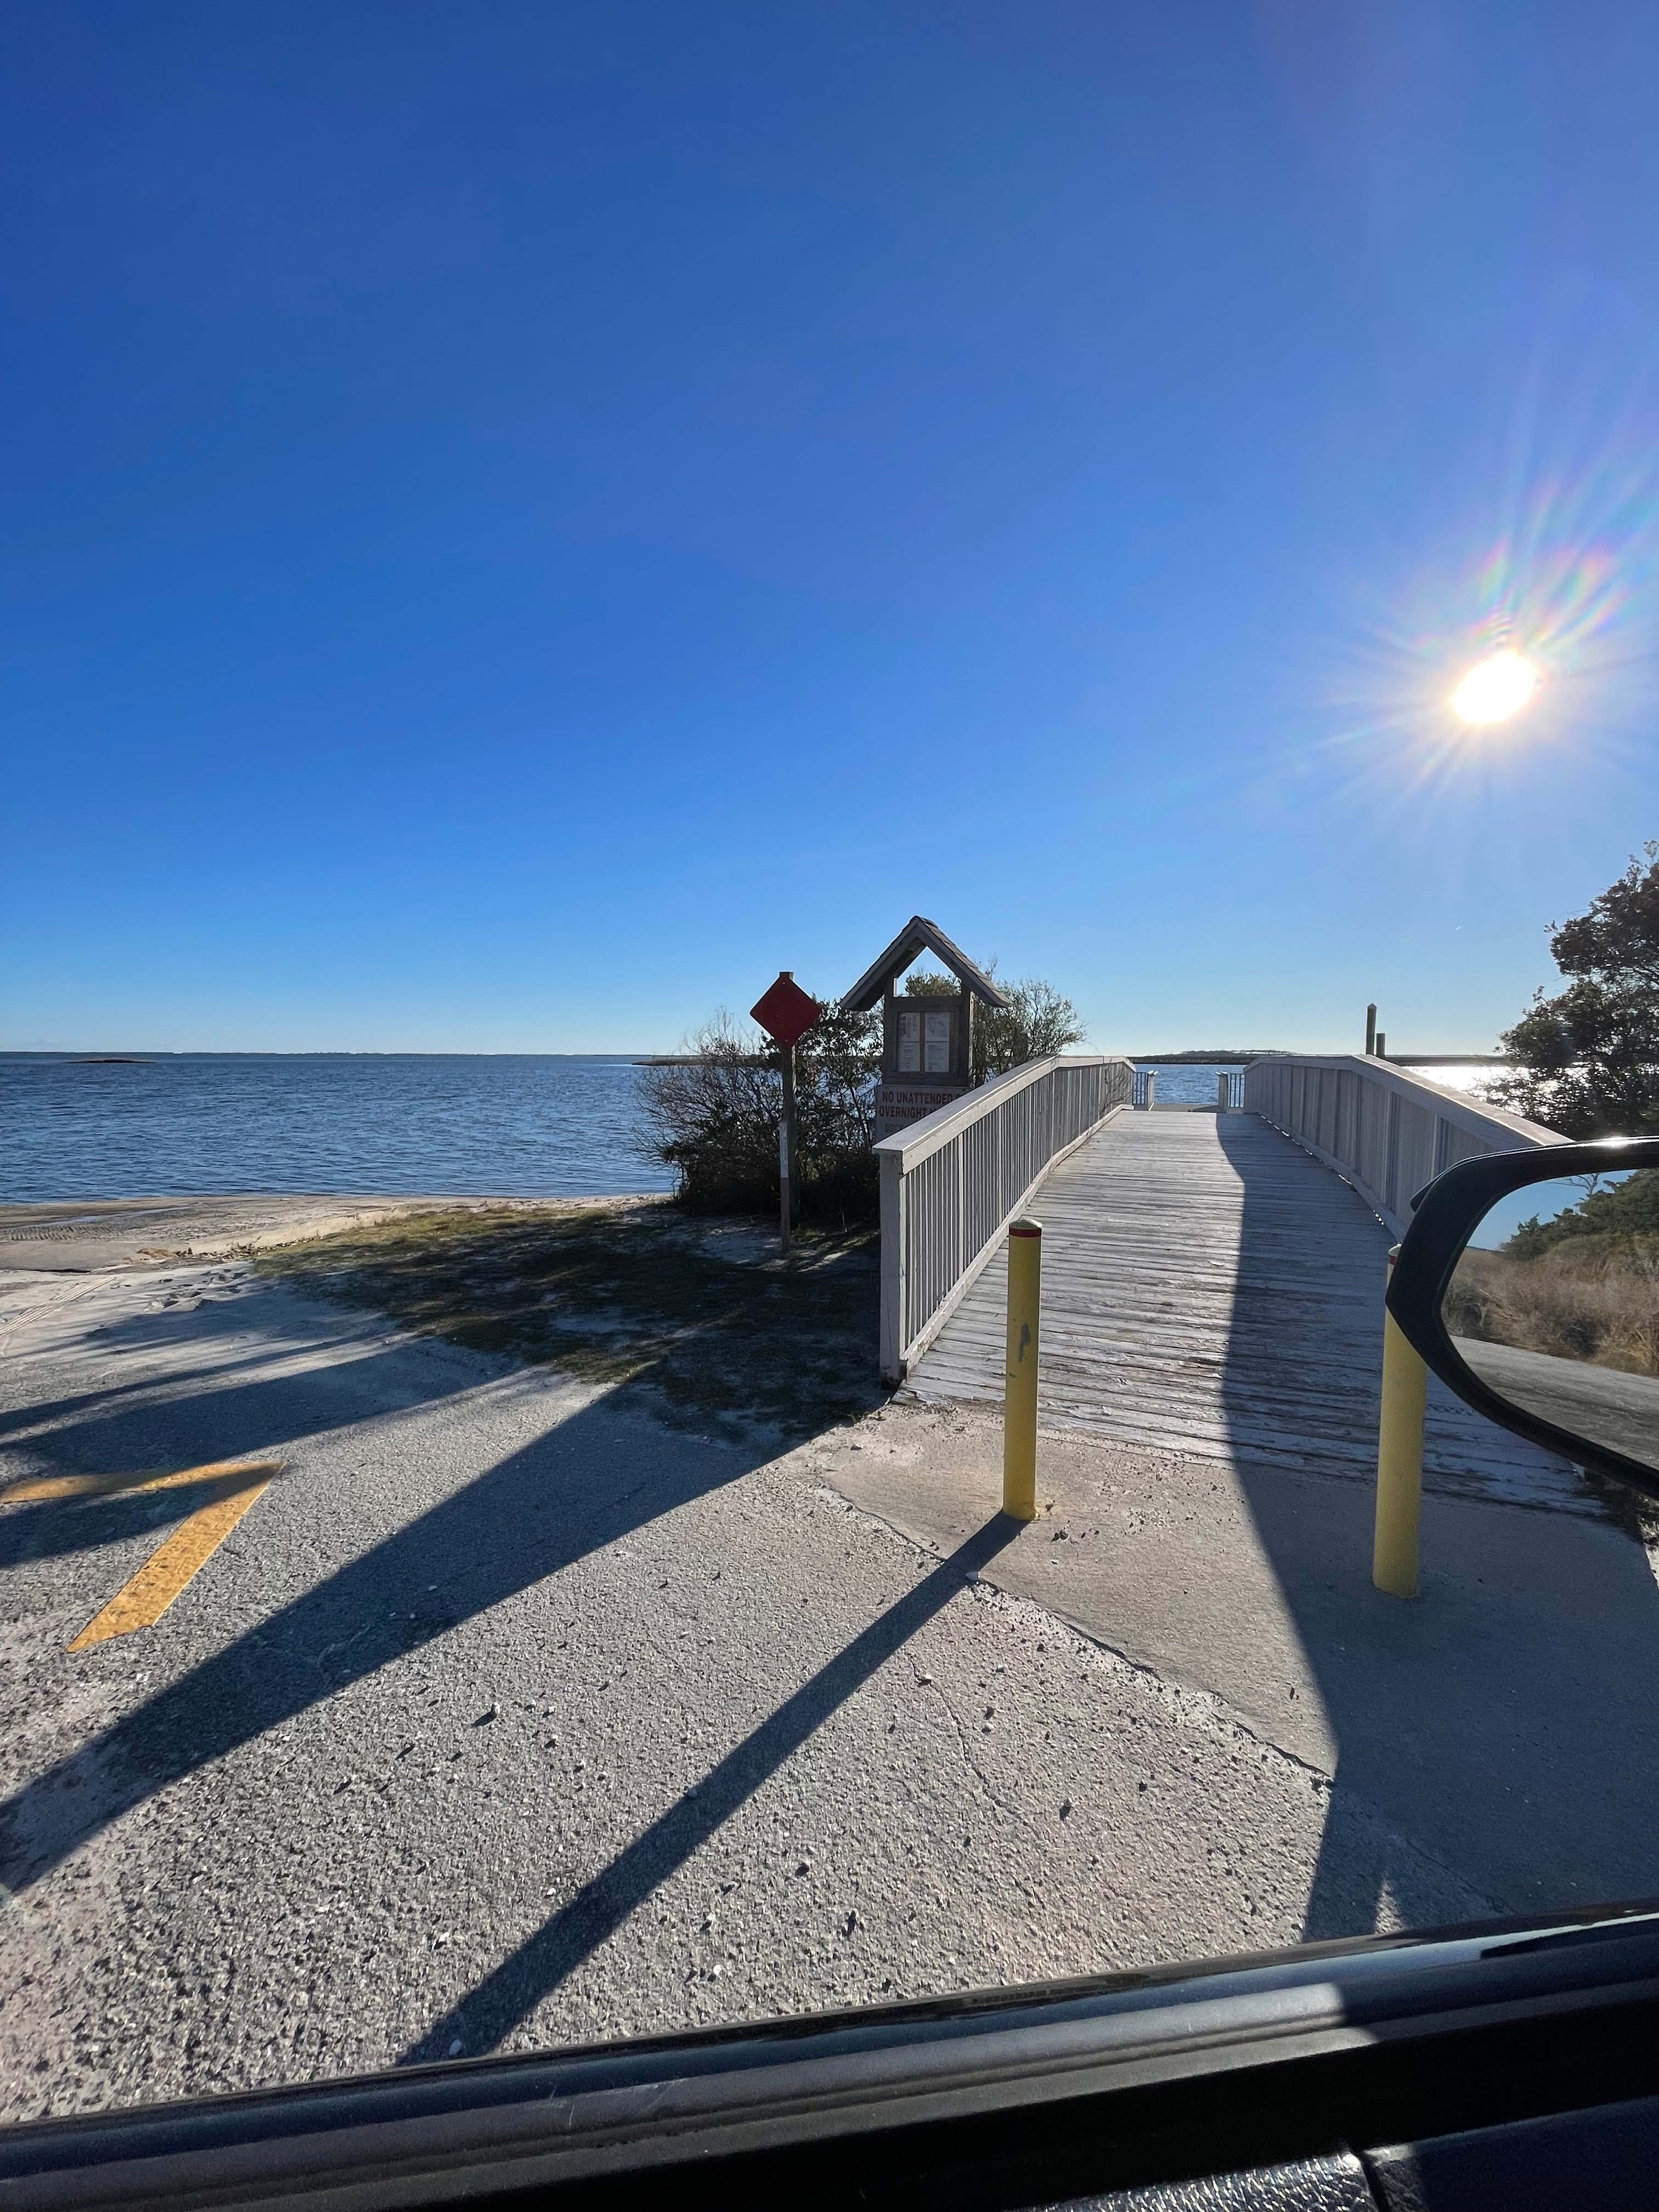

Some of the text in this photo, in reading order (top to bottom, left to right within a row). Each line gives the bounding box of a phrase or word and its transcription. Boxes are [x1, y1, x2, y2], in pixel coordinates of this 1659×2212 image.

[882, 1091, 894, 1103] NO
[896, 1092, 953, 1104] UNATTENDED
[879, 1105, 927, 1118] OVERNIGHT
